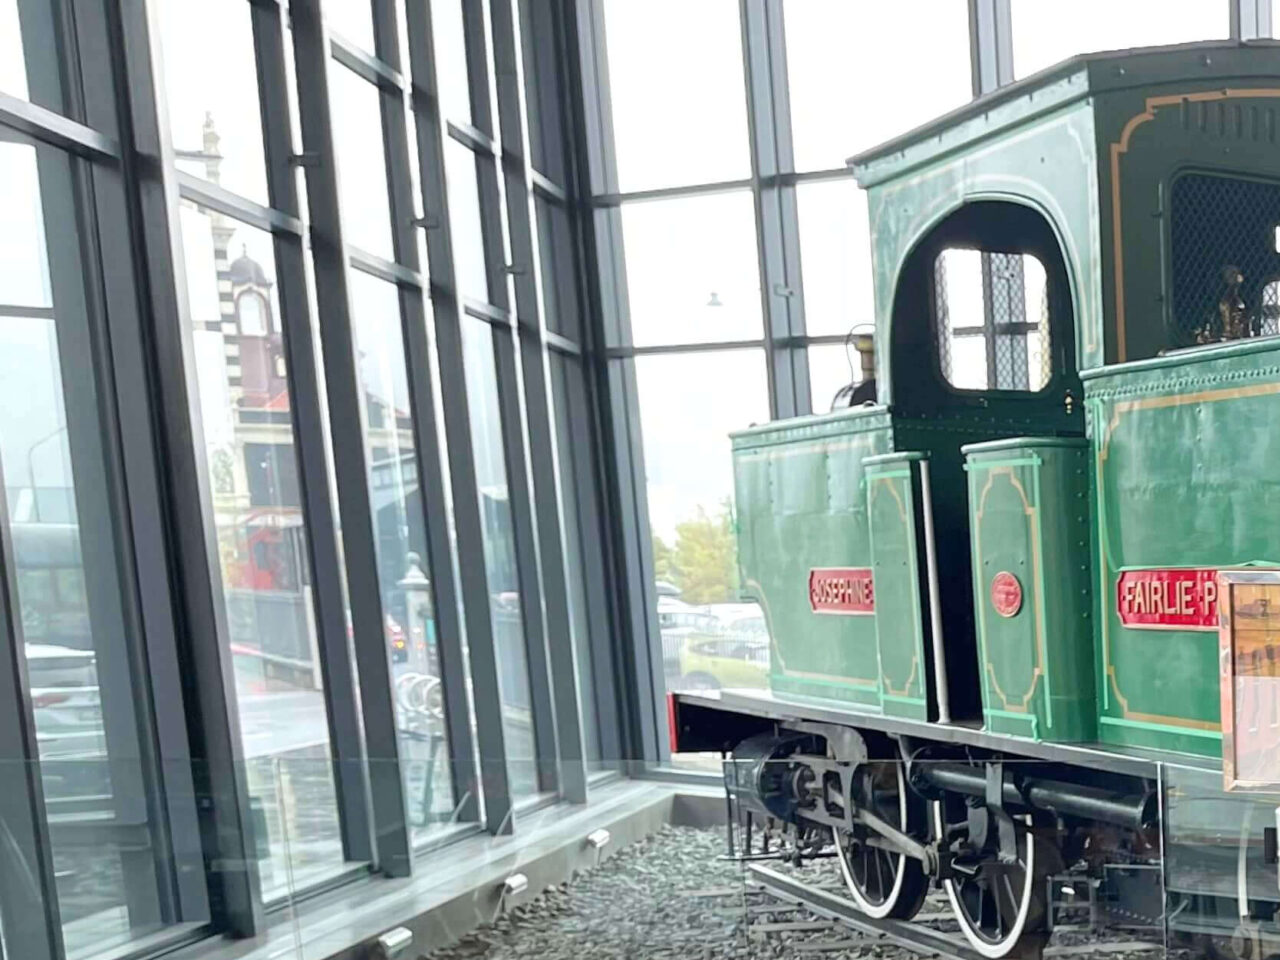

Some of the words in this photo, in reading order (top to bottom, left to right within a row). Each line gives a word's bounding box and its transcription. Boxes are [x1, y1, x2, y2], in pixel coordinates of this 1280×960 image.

[814, 579, 871, 603] JOSEPHINE
[1125, 581, 1195, 615] FAIRLIE
[1204, 581, 1216, 615] P
